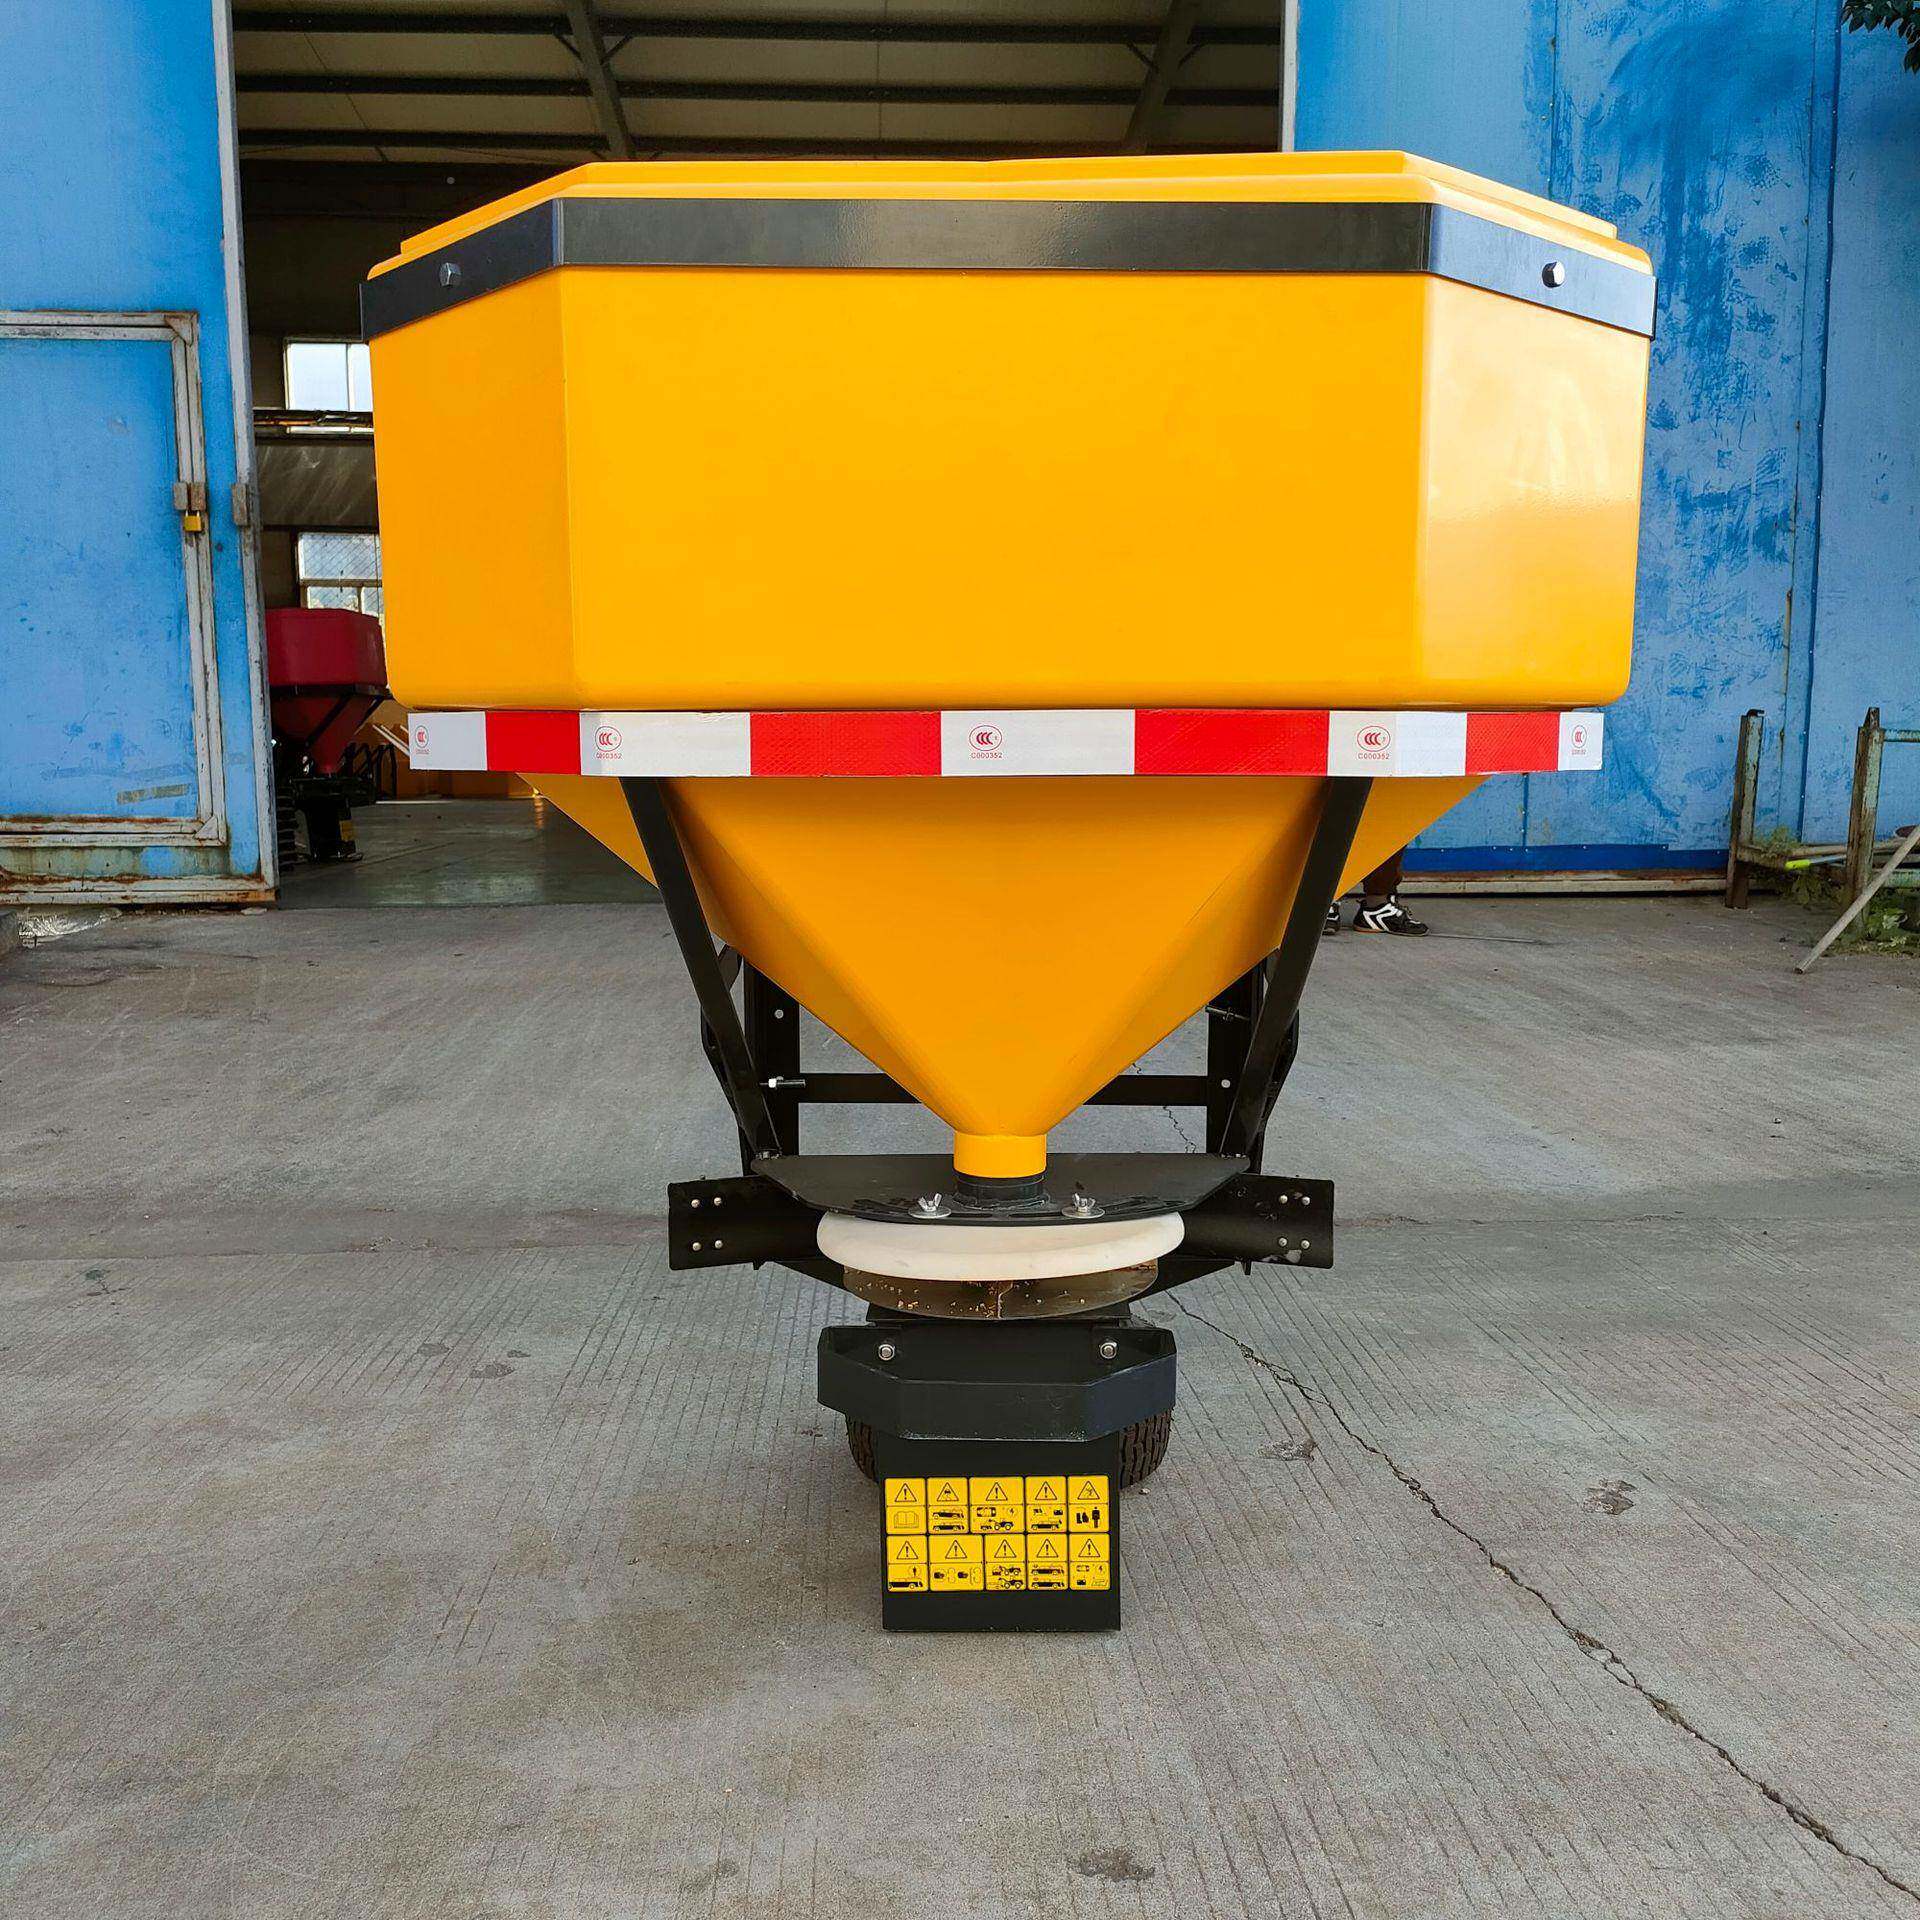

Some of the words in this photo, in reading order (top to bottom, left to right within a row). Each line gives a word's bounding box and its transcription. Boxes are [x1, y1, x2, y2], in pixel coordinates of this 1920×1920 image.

[599, 732, 613, 746] CCC
[976, 731, 993, 745] CCC
[1364, 732, 1381, 746] CCC
[1357, 752, 1390, 760] C000352
